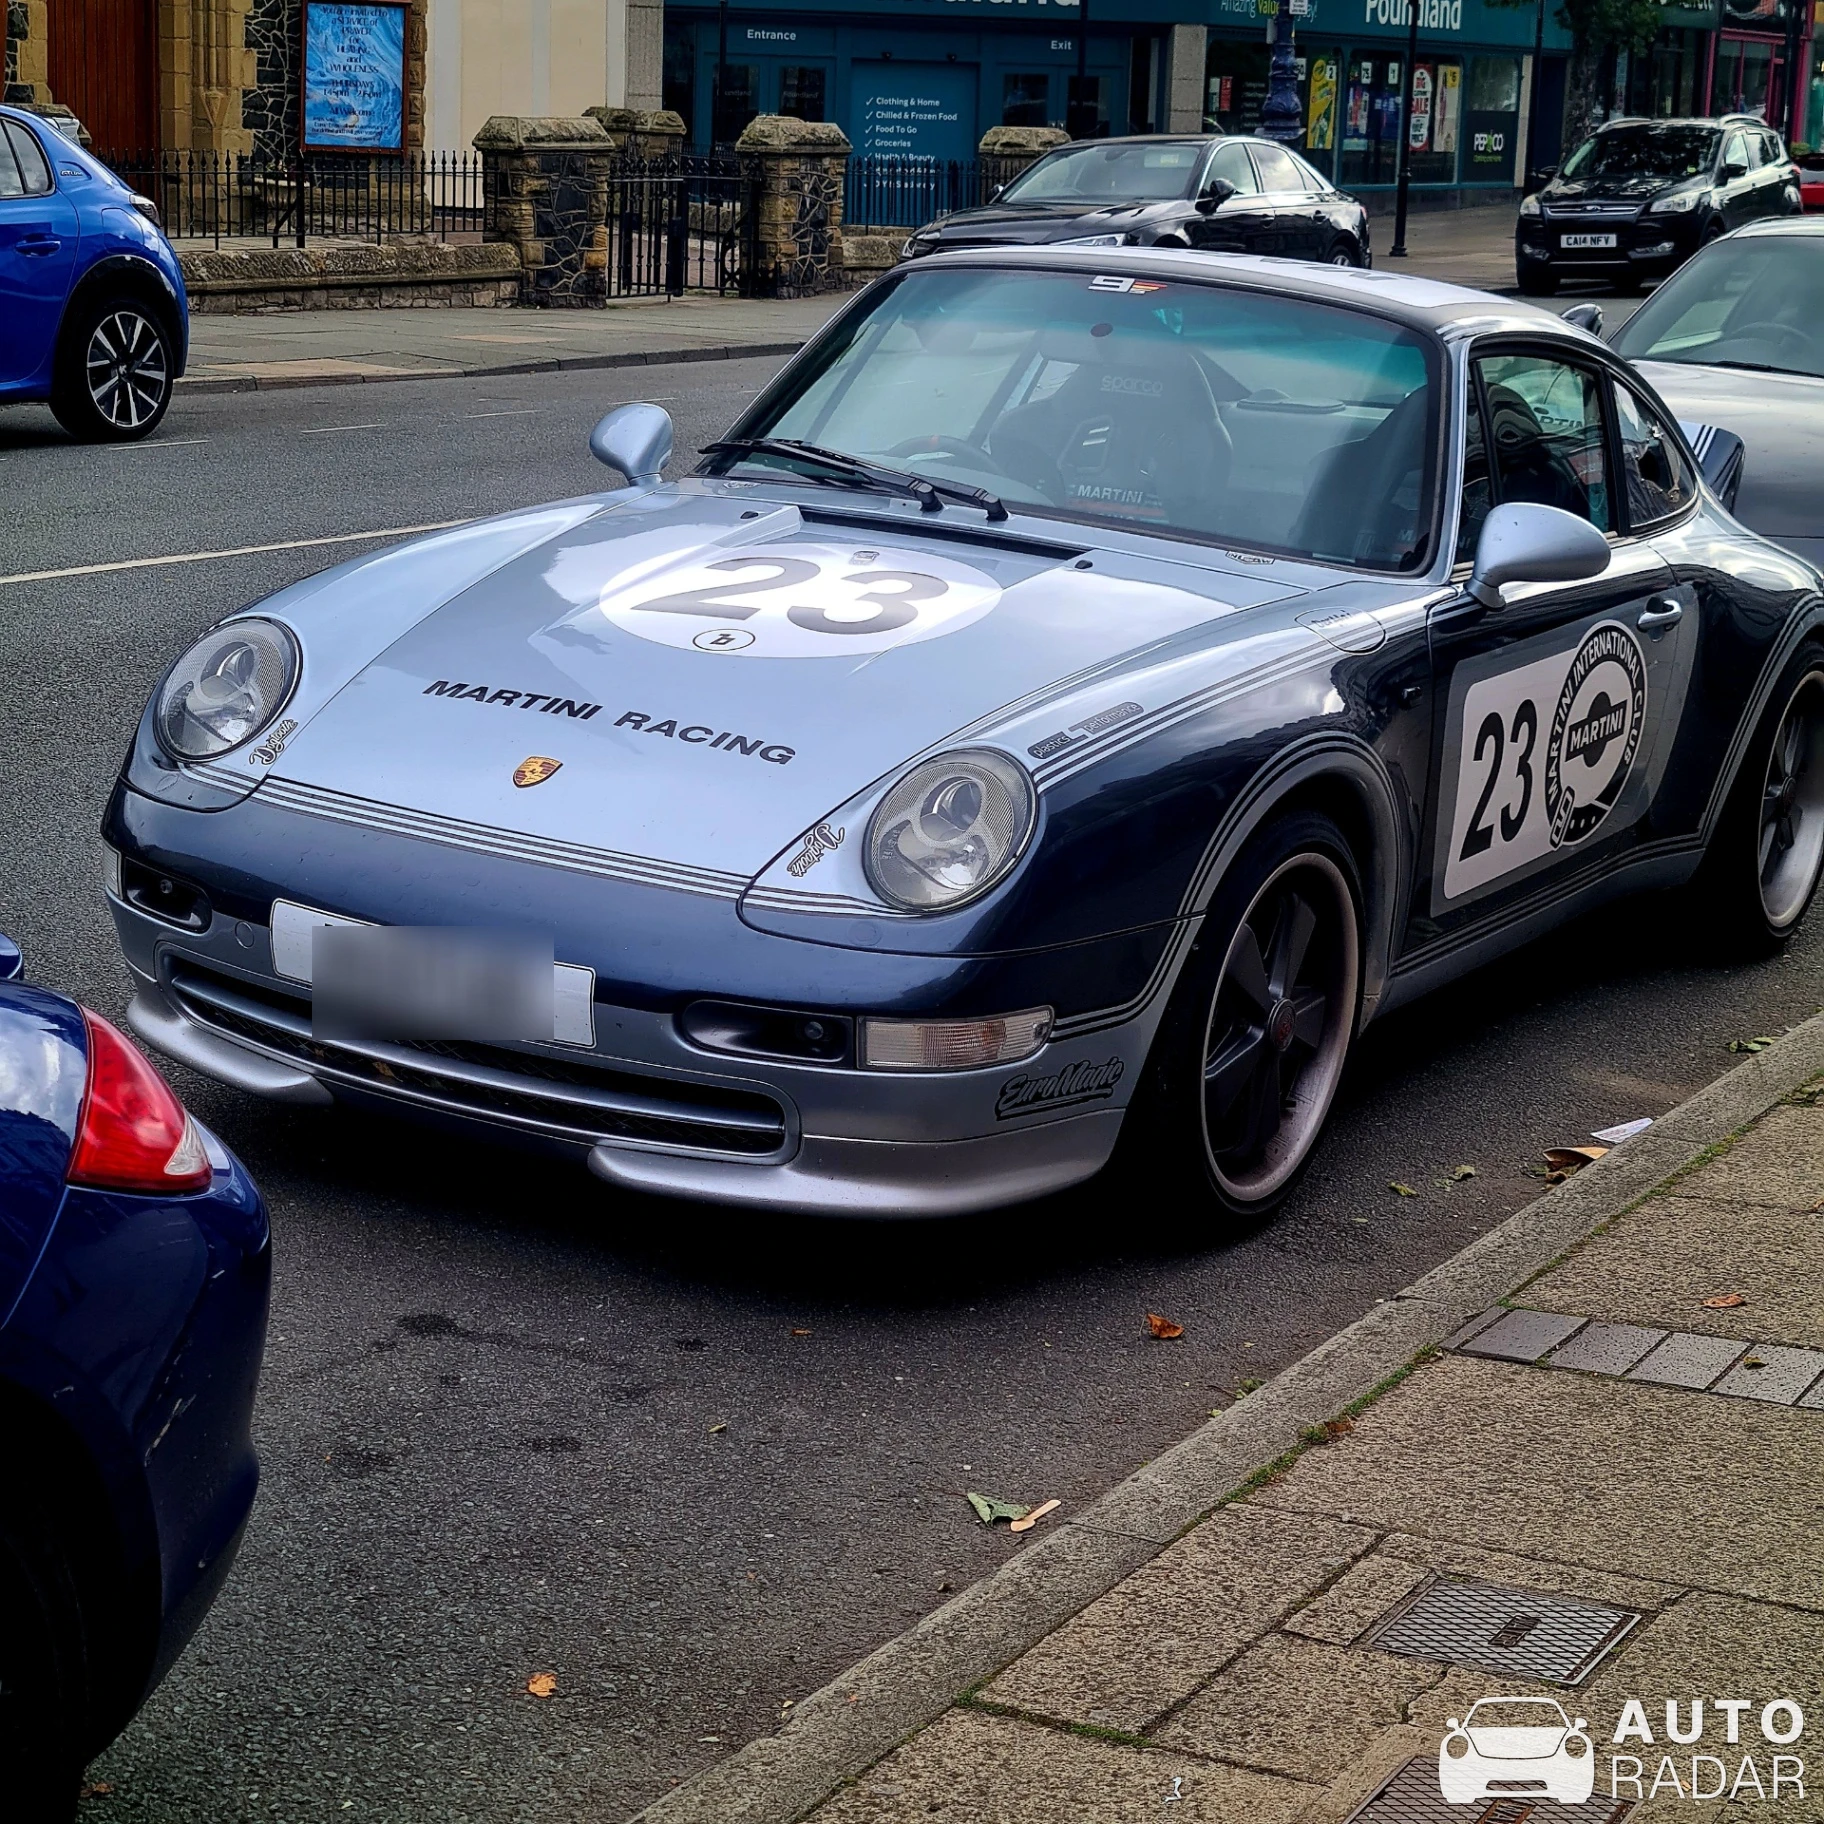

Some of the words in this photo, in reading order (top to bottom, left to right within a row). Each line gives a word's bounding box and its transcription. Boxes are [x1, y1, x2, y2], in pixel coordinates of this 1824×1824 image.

[747, 29, 797, 41] Entrance
[1051, 40, 1072, 50] Exit
[876, 97, 908, 107] Clothing
[910, 98, 916, 106] &
[917, 98, 940, 106] Home
[876, 111, 902, 119] Chilled
[911, 112, 937, 120] Frozen
[938, 113, 958, 121] Food
[875, 125, 894, 133] Food
[875, 138, 911, 147] Groceries
[1566, 236, 1587, 246] CA14
[1590, 236, 1610, 246] NFV
[1102, 375, 1163, 394] sparco
[1077, 484, 1144, 504] MARTINI
[630, 556, 949, 635] 23
[421, 679, 603, 721] MARTINI
[613, 711, 797, 766] RACING
[1548, 679, 1574, 806] MARTINI
[1573, 631, 1640, 688] INTERNATIONAL
[1624, 690, 1643, 765] CLUB
[1033, 734, 1071, 757] plastics
[1083, 703, 1141, 733] performance
[1569, 708, 1624, 752] MARTINI
[1459, 698, 1537, 863] 23
